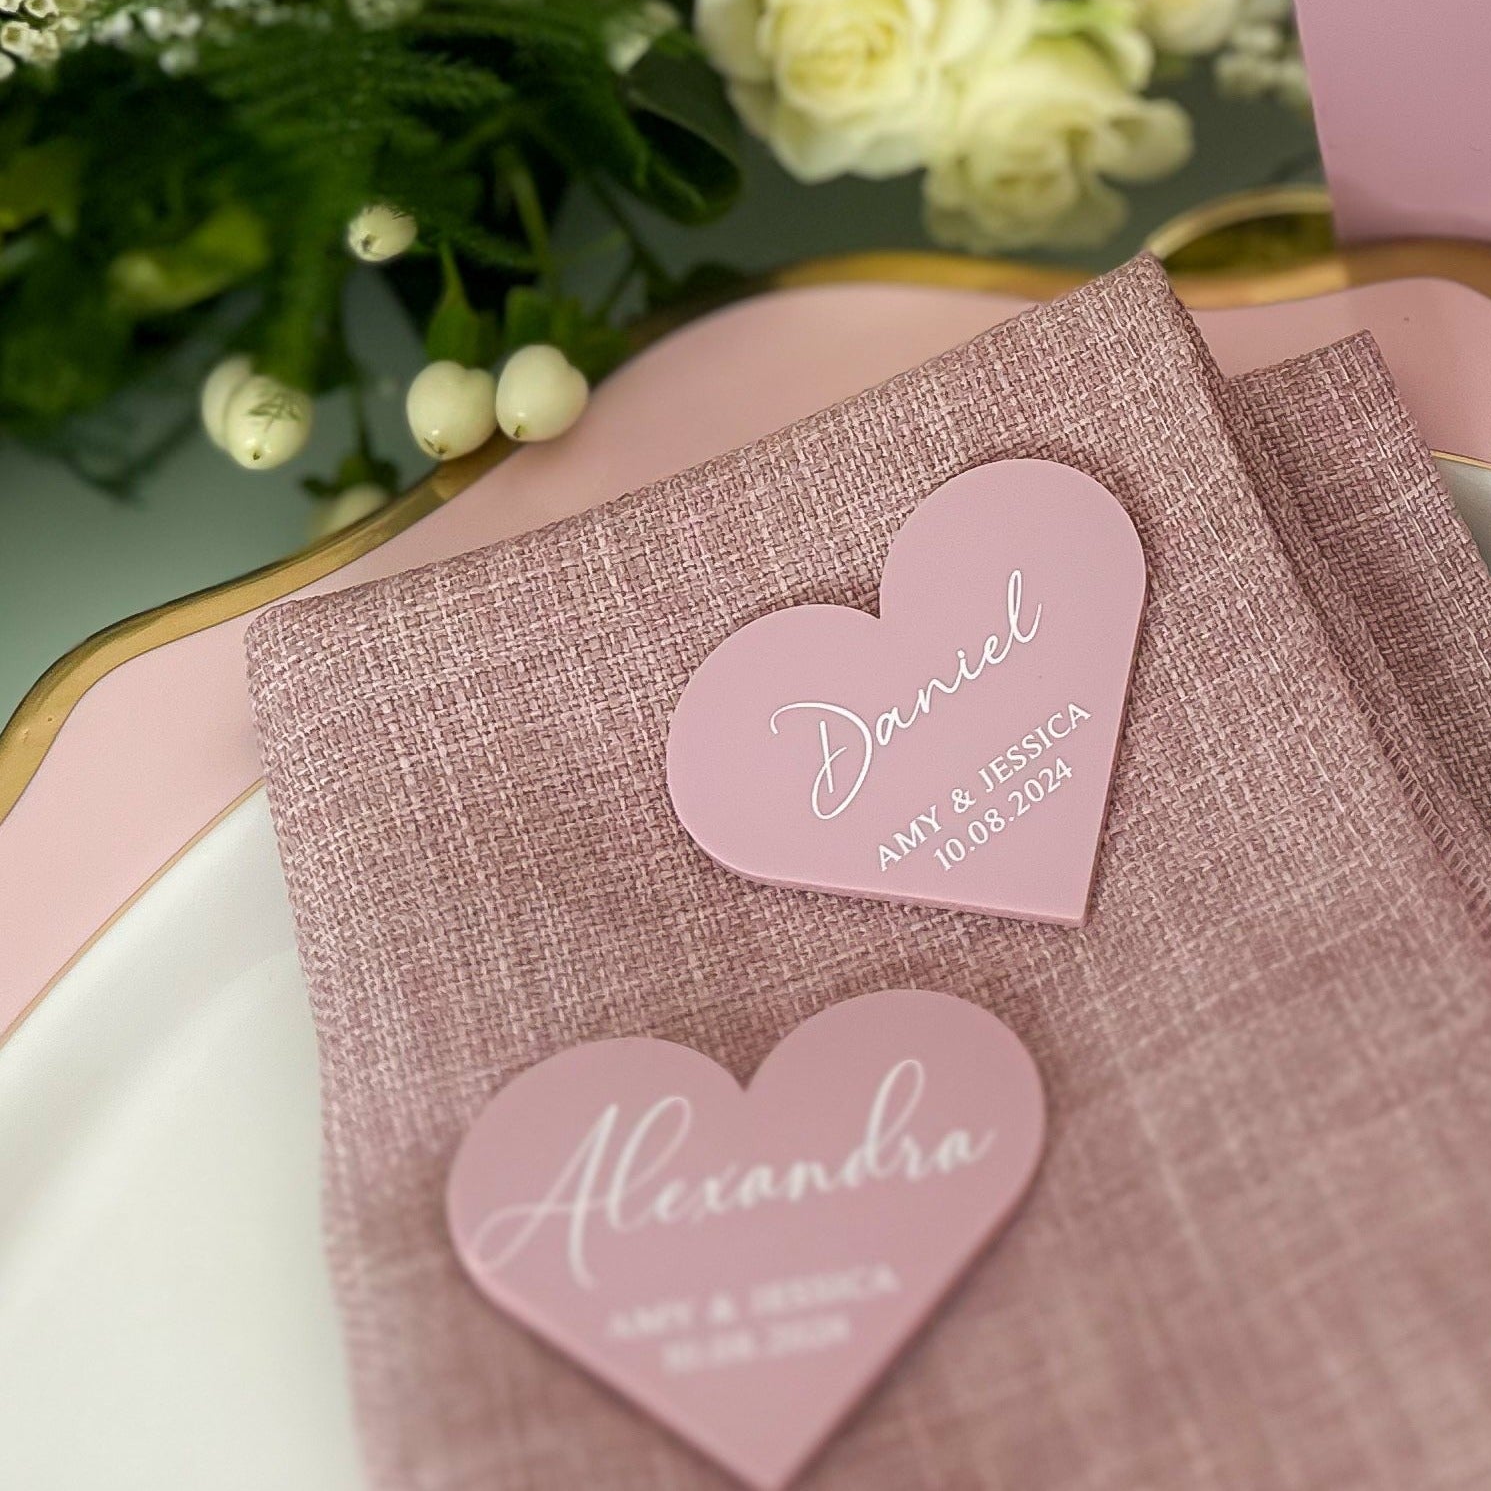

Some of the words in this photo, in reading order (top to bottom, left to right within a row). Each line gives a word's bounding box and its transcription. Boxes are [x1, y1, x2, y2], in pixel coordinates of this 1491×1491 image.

[769, 569, 1043, 821] Daniel
[876, 804, 942, 872] AMY
[951, 788, 976, 813] &
[977, 703, 1092, 793] JESSICA
[933, 757, 1073, 871] 10.08.2024
[470, 1058, 996, 1289] Alexandra
